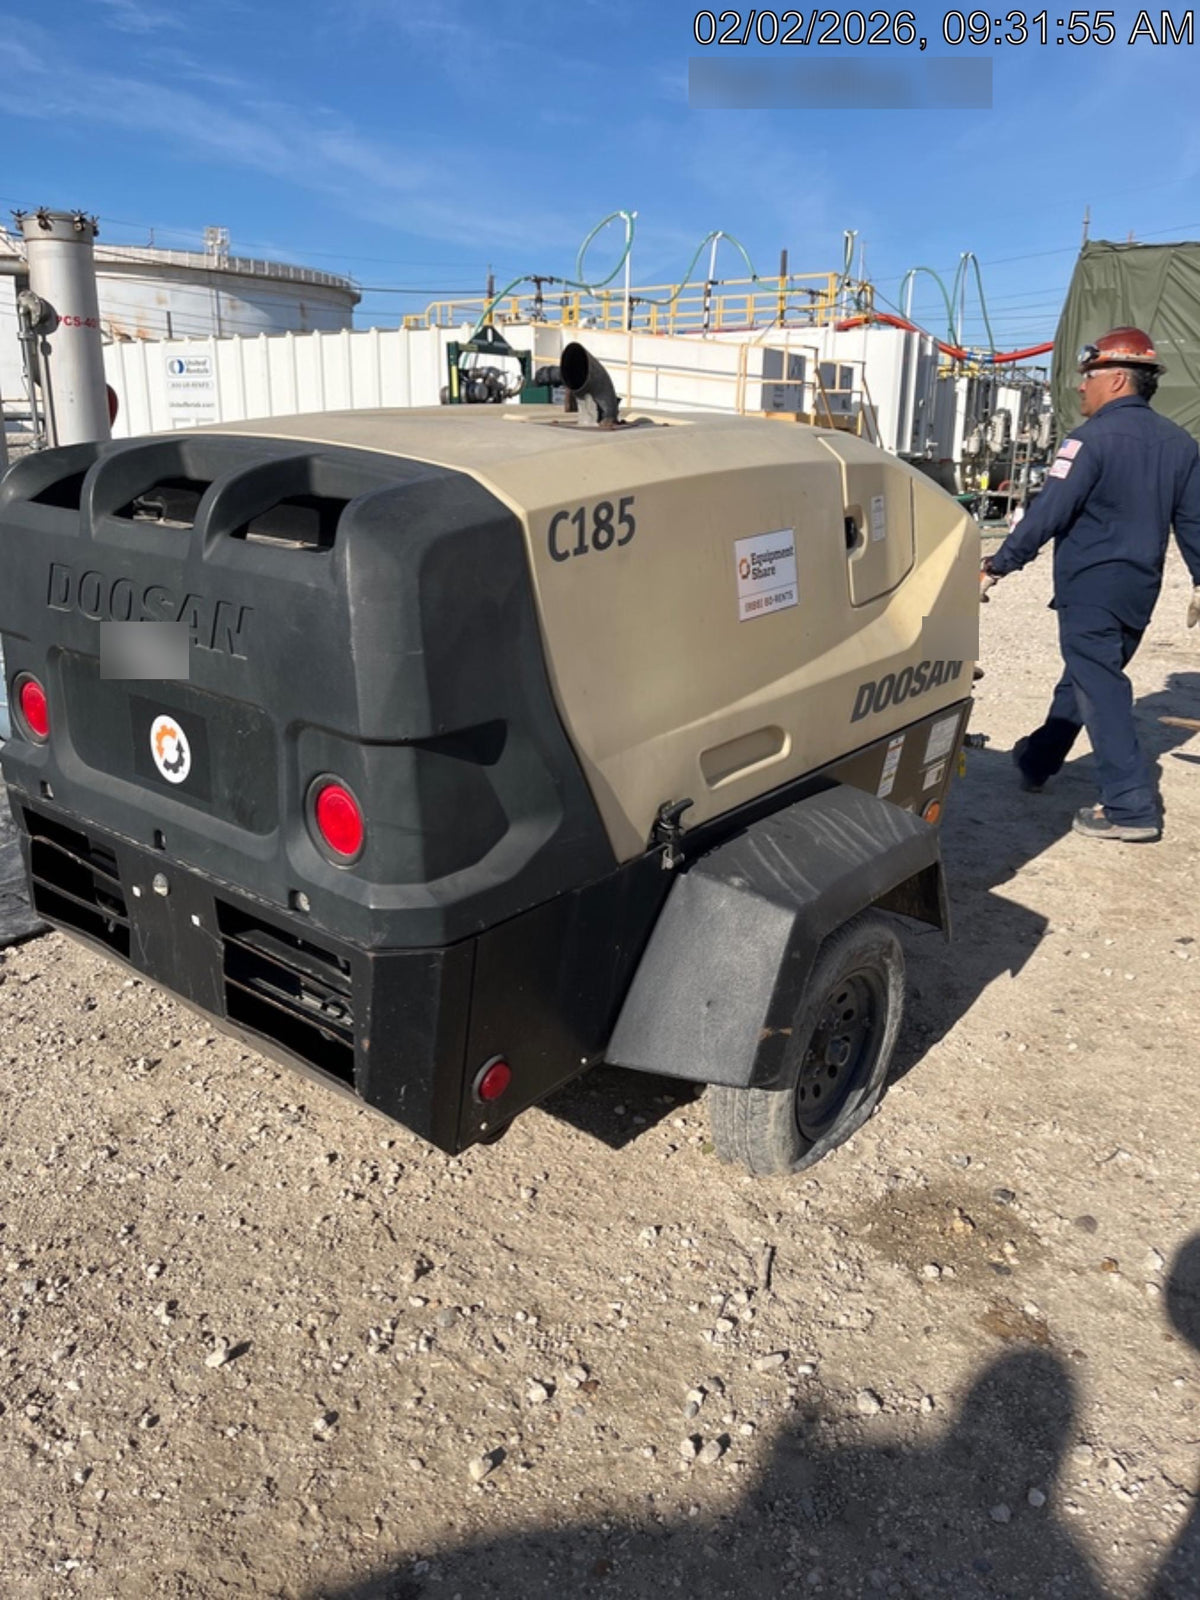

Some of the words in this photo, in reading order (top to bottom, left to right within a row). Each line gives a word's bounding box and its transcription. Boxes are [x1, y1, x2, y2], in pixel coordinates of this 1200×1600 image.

[548, 495, 636, 562] C185
[750, 546, 794, 566] Equipment
[751, 566, 776, 580] Share
[47, 562, 254, 661] DOOSAN
[849, 660, 963, 724] DOOSAN
